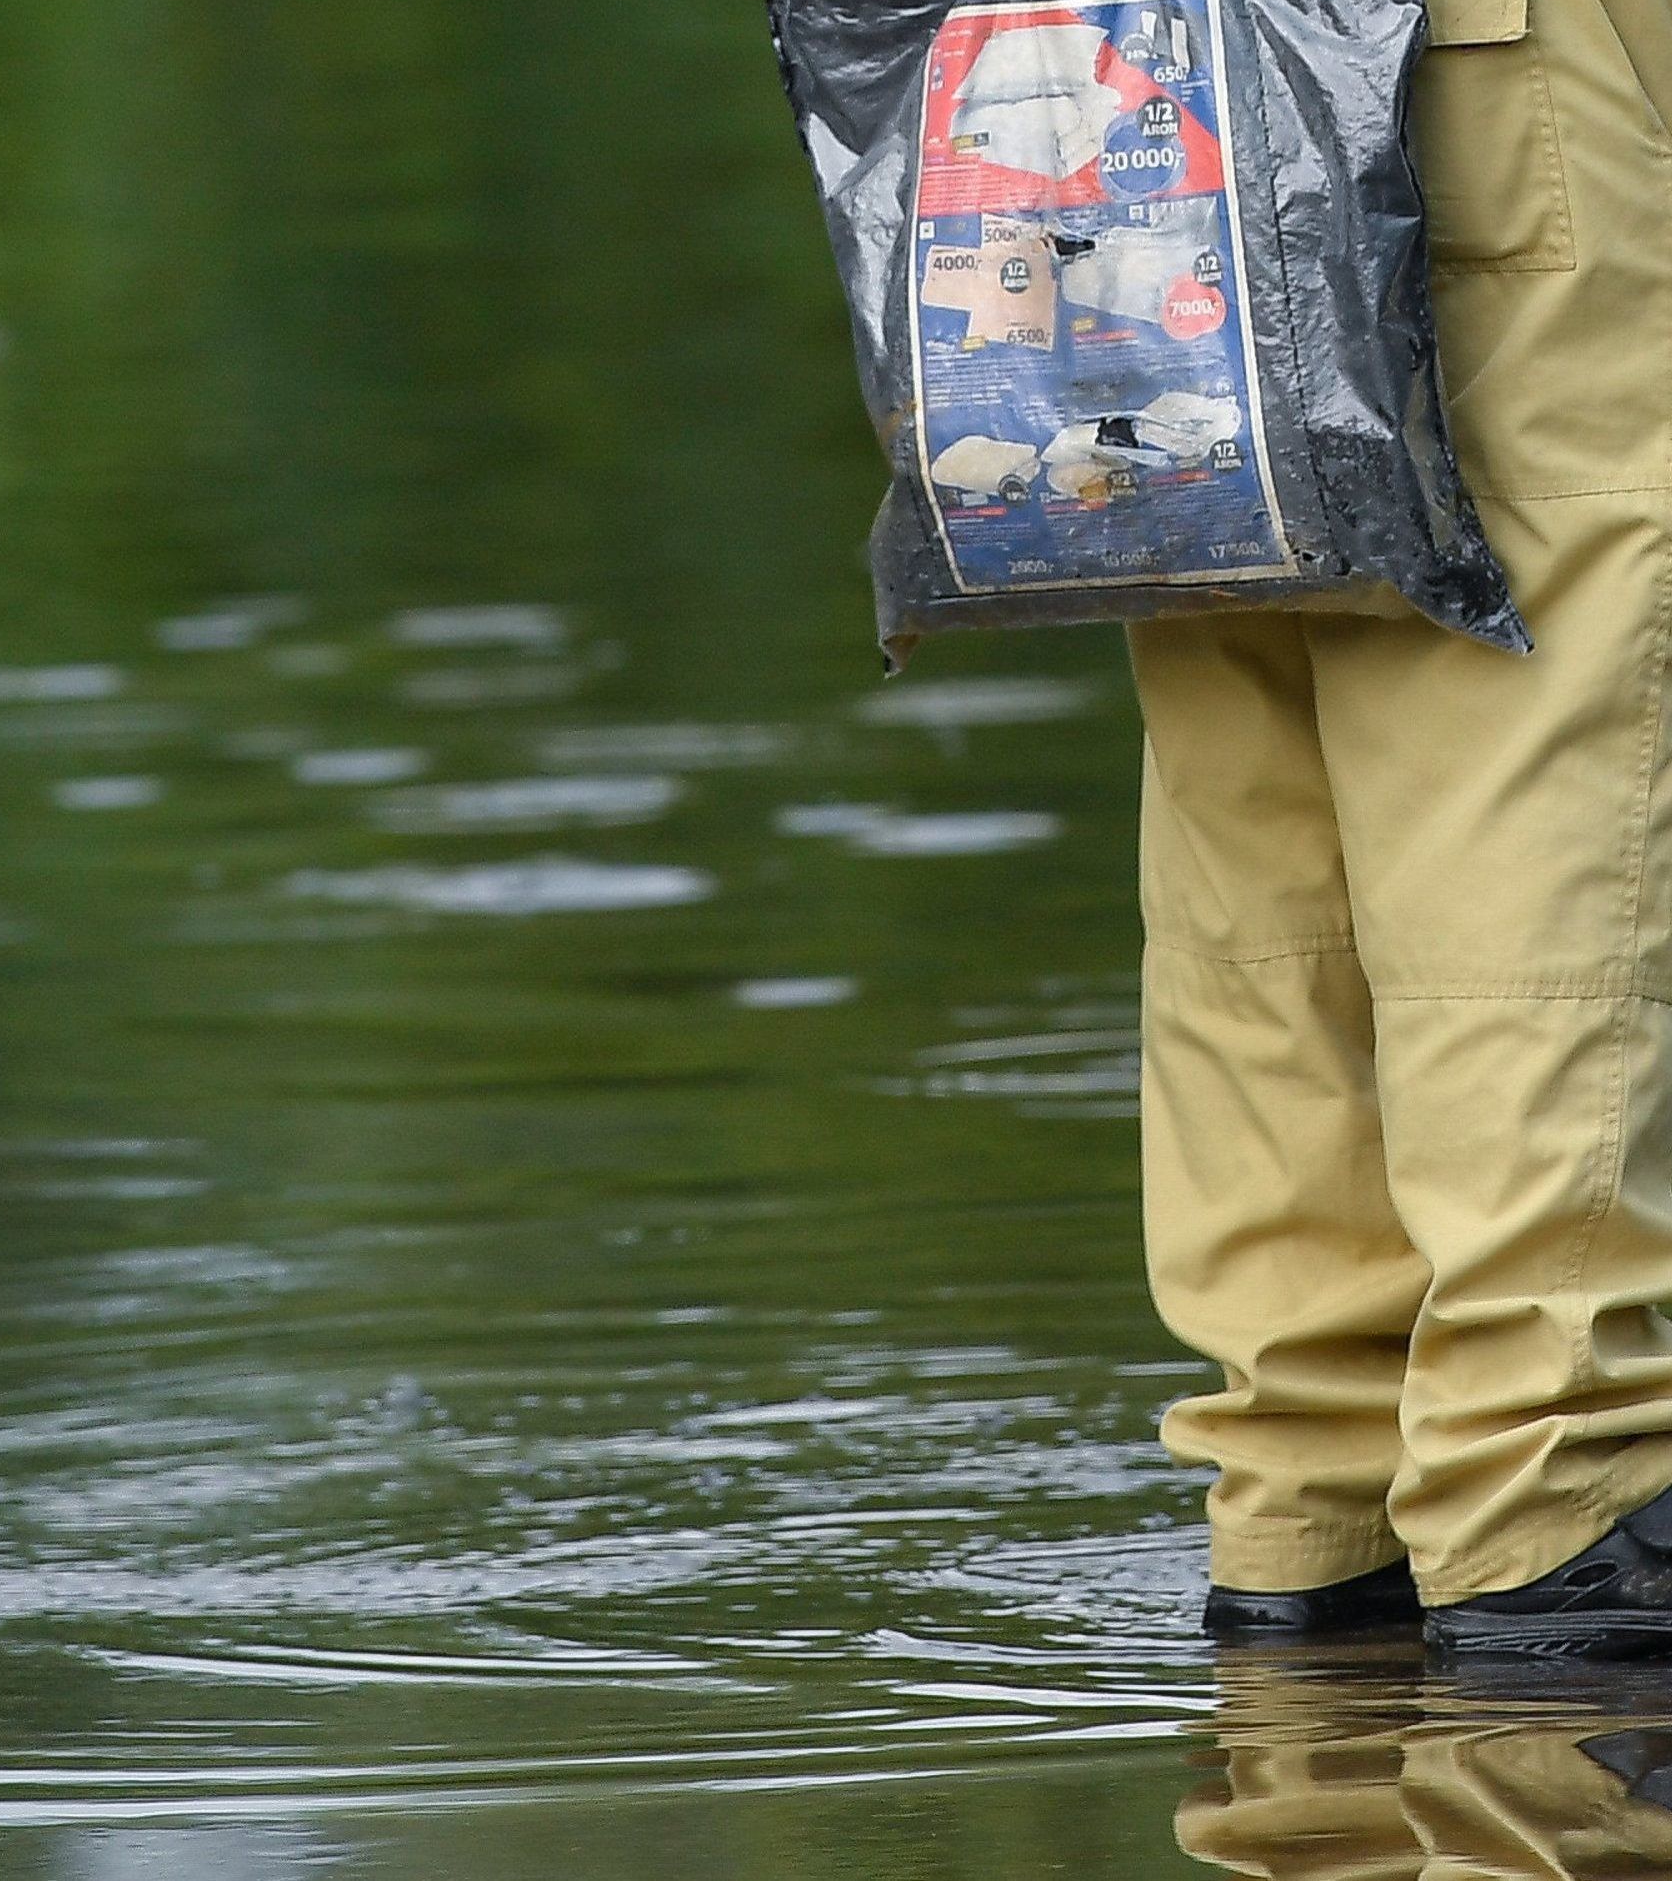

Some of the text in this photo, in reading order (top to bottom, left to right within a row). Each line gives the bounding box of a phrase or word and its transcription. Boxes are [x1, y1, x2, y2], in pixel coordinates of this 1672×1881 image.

[1144, 102, 1174, 122] 1/2
[1101, 151, 1128, 173] 20
[1214, 442, 1237, 458] 1/2
